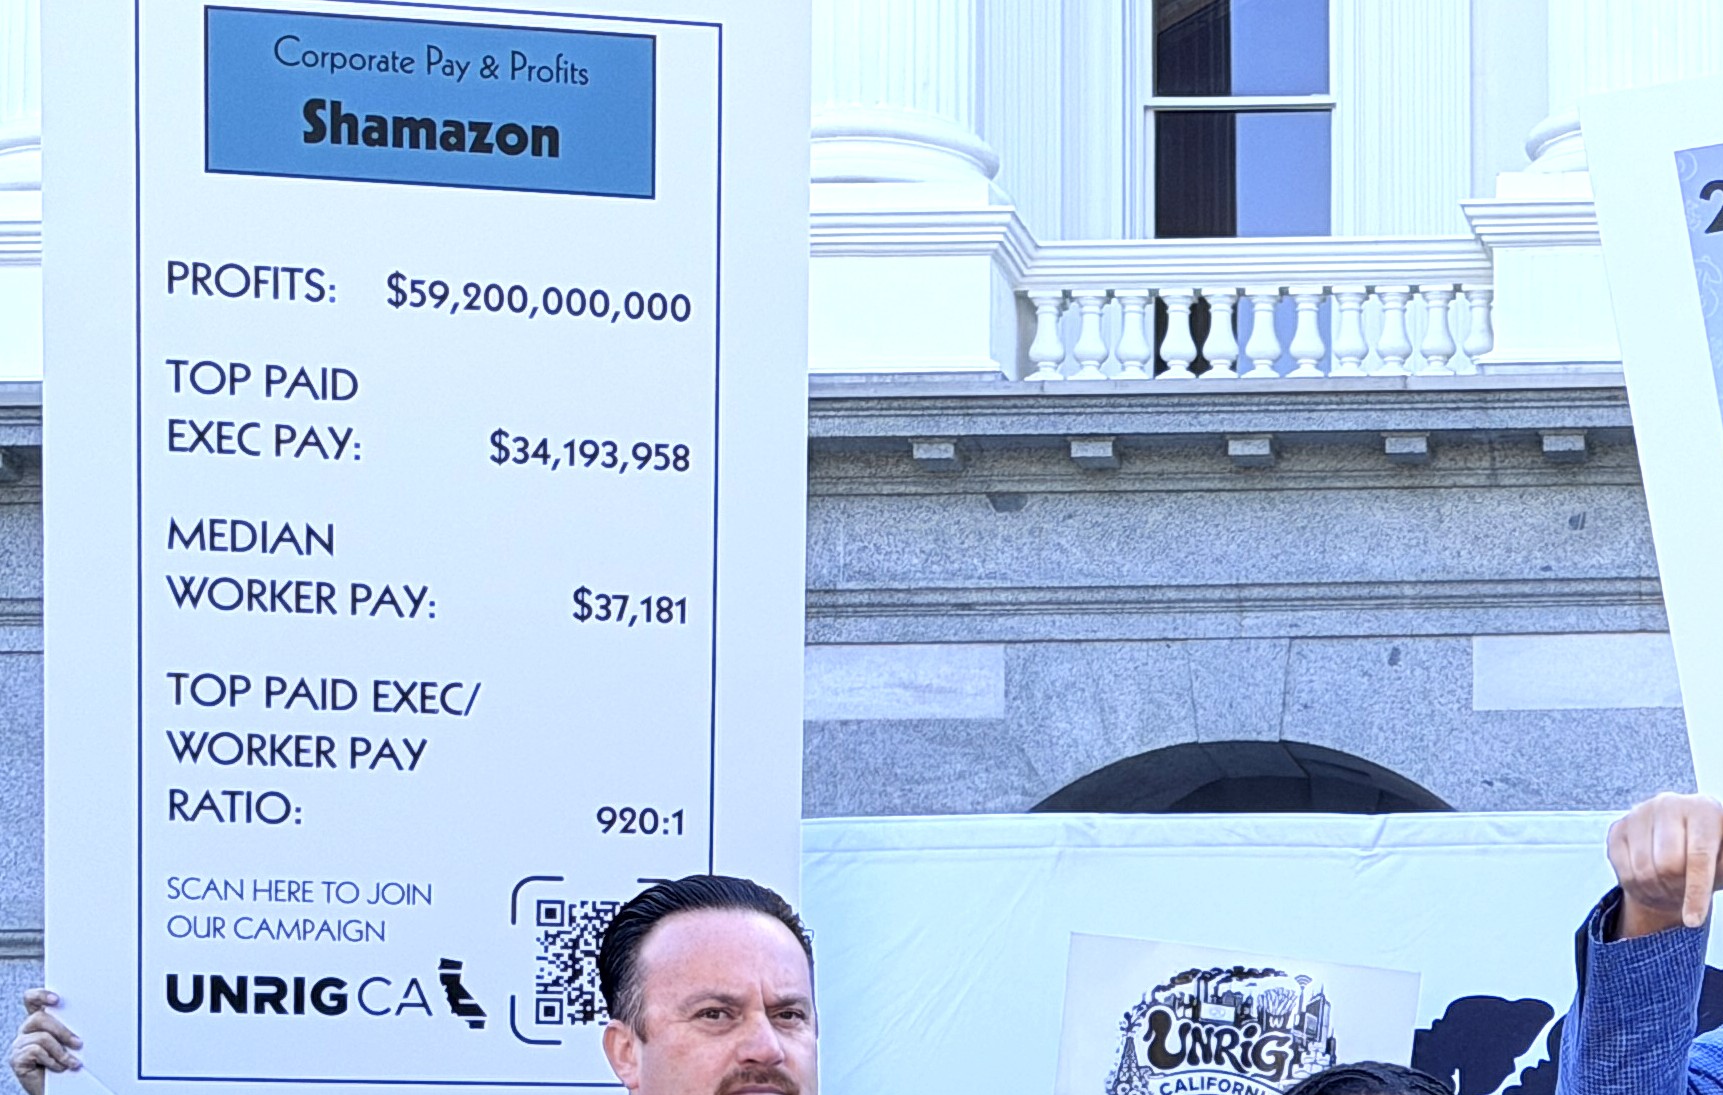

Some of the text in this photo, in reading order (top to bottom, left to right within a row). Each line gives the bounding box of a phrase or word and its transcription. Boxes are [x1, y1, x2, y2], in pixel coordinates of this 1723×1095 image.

[273, 34, 590, 86] Corporate Pay & Profits
[302, 98, 560, 158] Shamazon
[166, 260, 692, 324] PROFITS: $59,200,000,000
[165, 358, 359, 402] TOP PAID
[166, 418, 691, 475] EXEC PAY: $34,193,958
[166, 517, 335, 557] MEDIAN
[165, 574, 688, 628] WORKER PAY: $37,181
[166, 672, 482, 717] TOP PAID EXEC/
[165, 730, 428, 772] WORKER PAY
[167, 788, 685, 837] RATIO: 920:1
[167, 876, 432, 906] SCAN HERE TO JOIN
[167, 914, 386, 943] OUR CAMPAIGN
